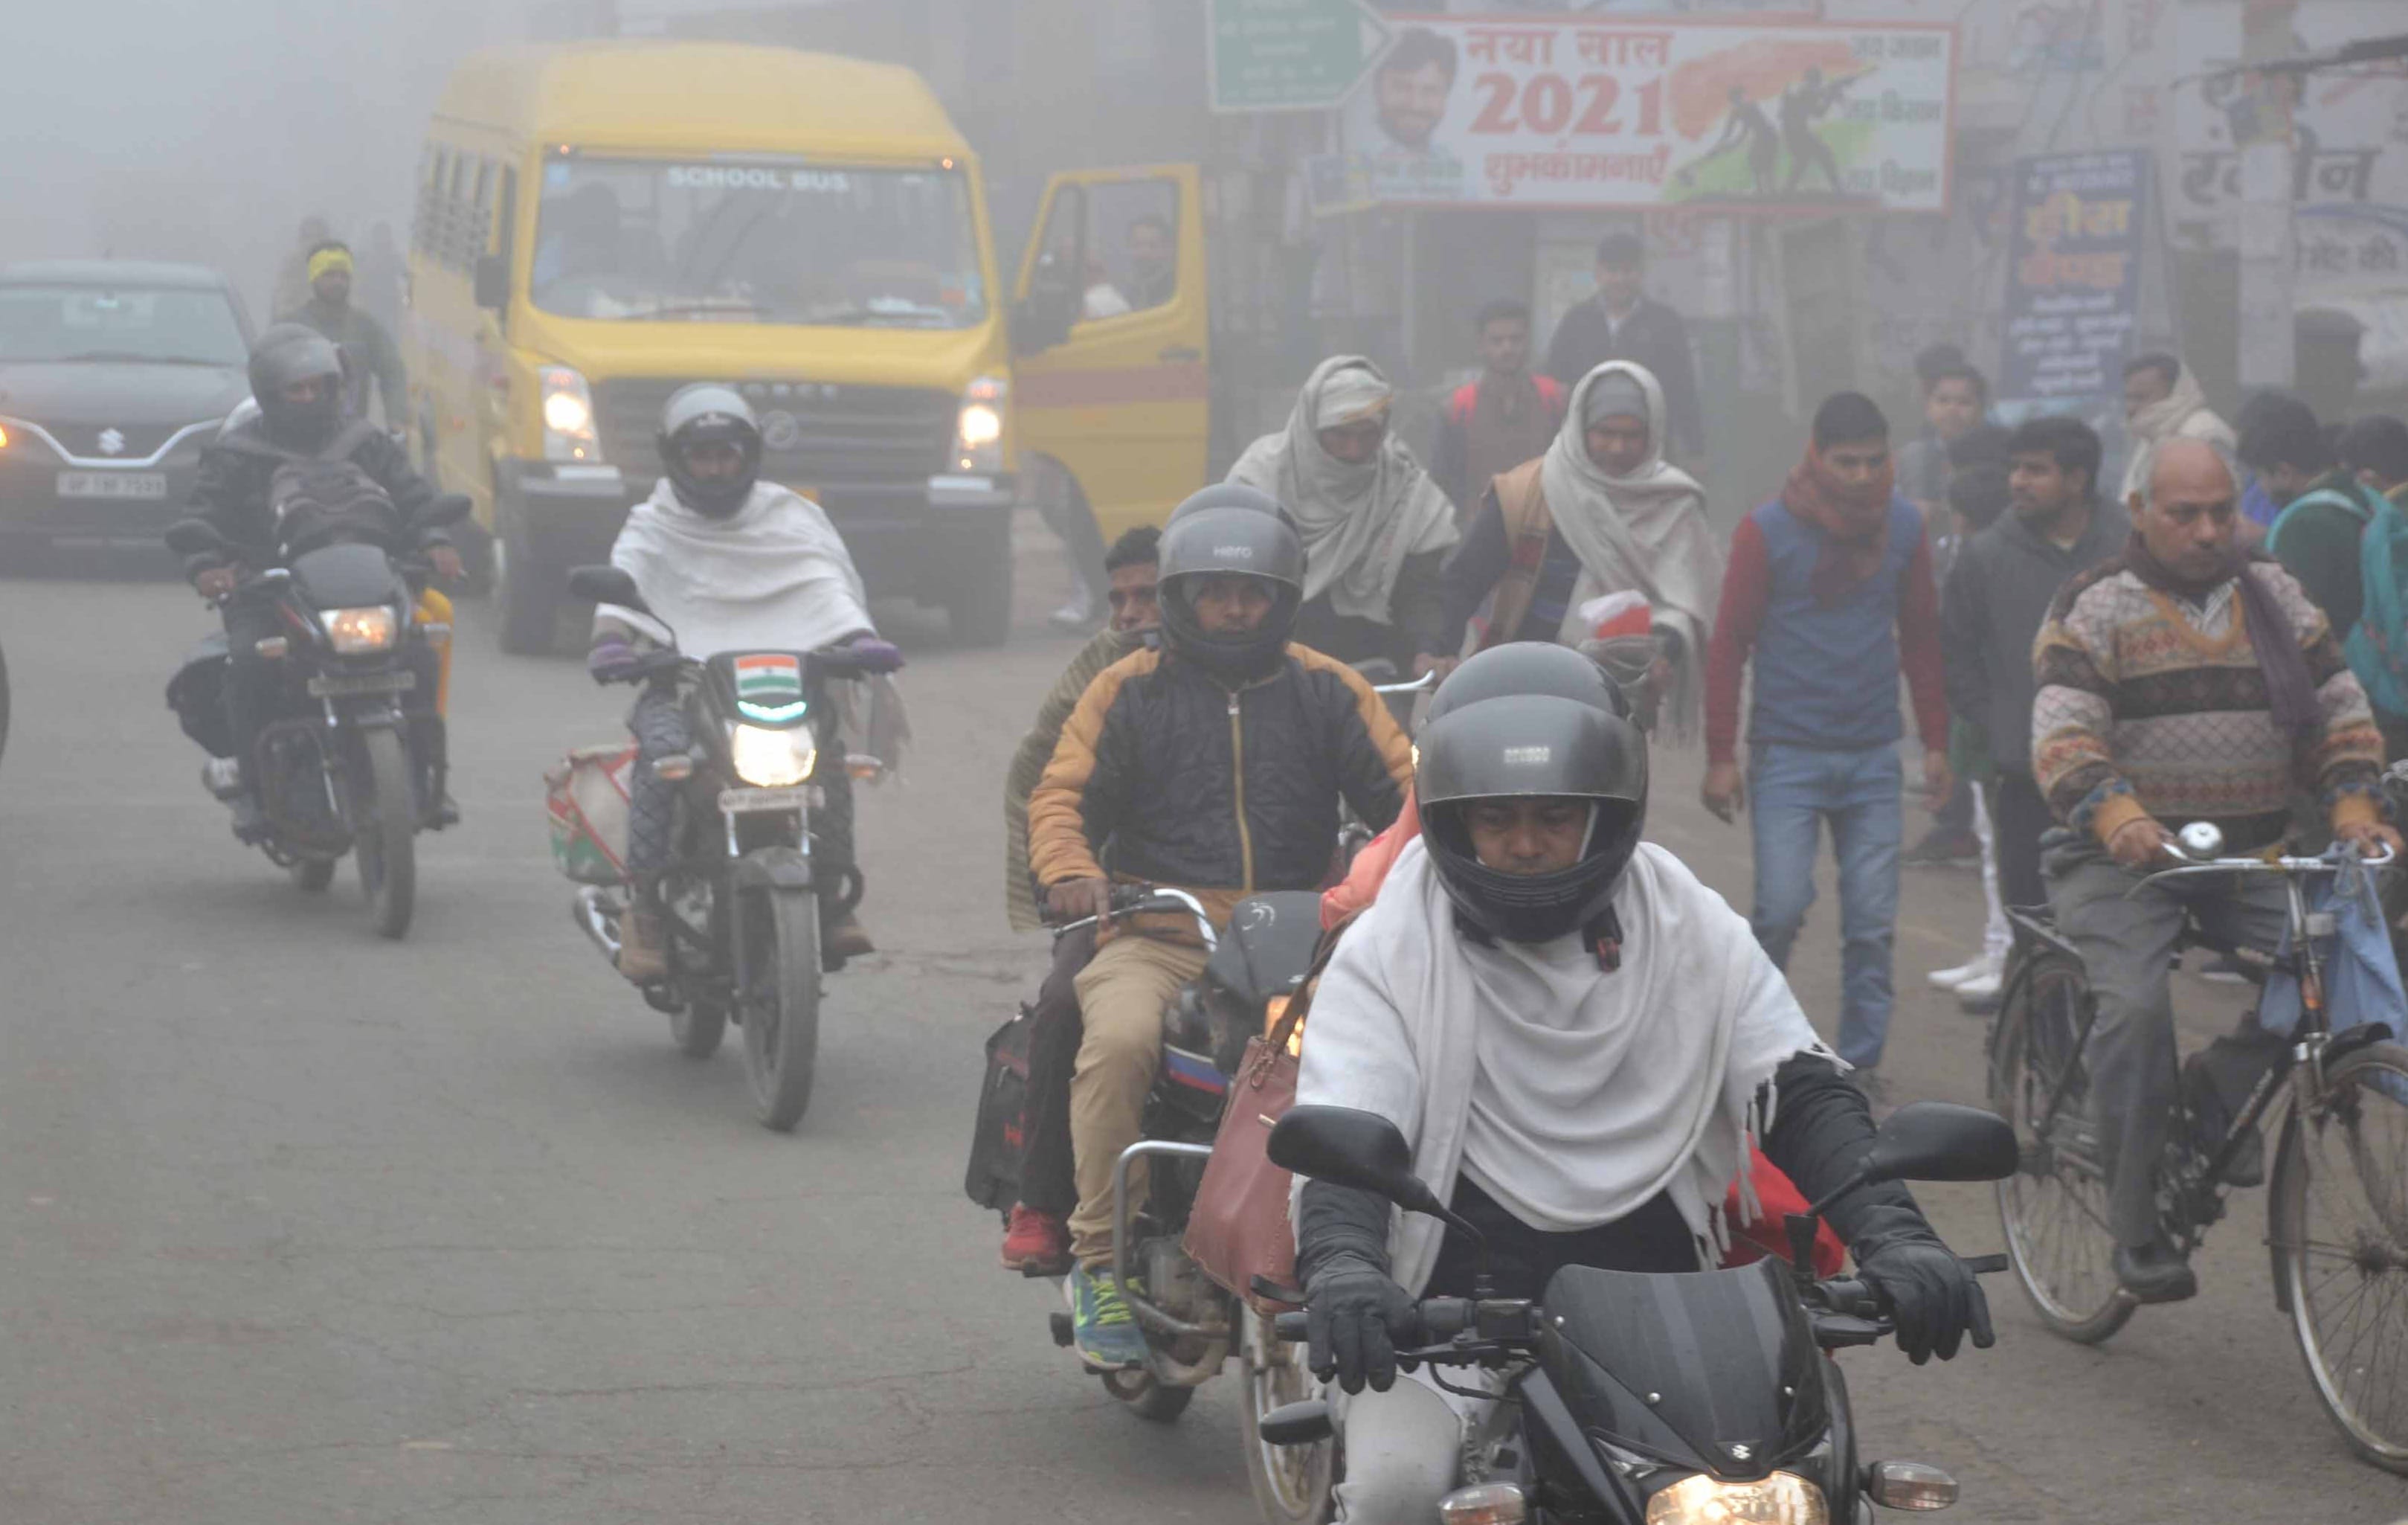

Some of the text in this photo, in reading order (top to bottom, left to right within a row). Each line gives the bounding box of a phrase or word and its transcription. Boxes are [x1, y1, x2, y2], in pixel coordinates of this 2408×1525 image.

[1465, 30, 1675, 67] नया साल
[1470, 71, 1664, 136] 2021
[669, 166, 849, 193] SCHOOL BUS
